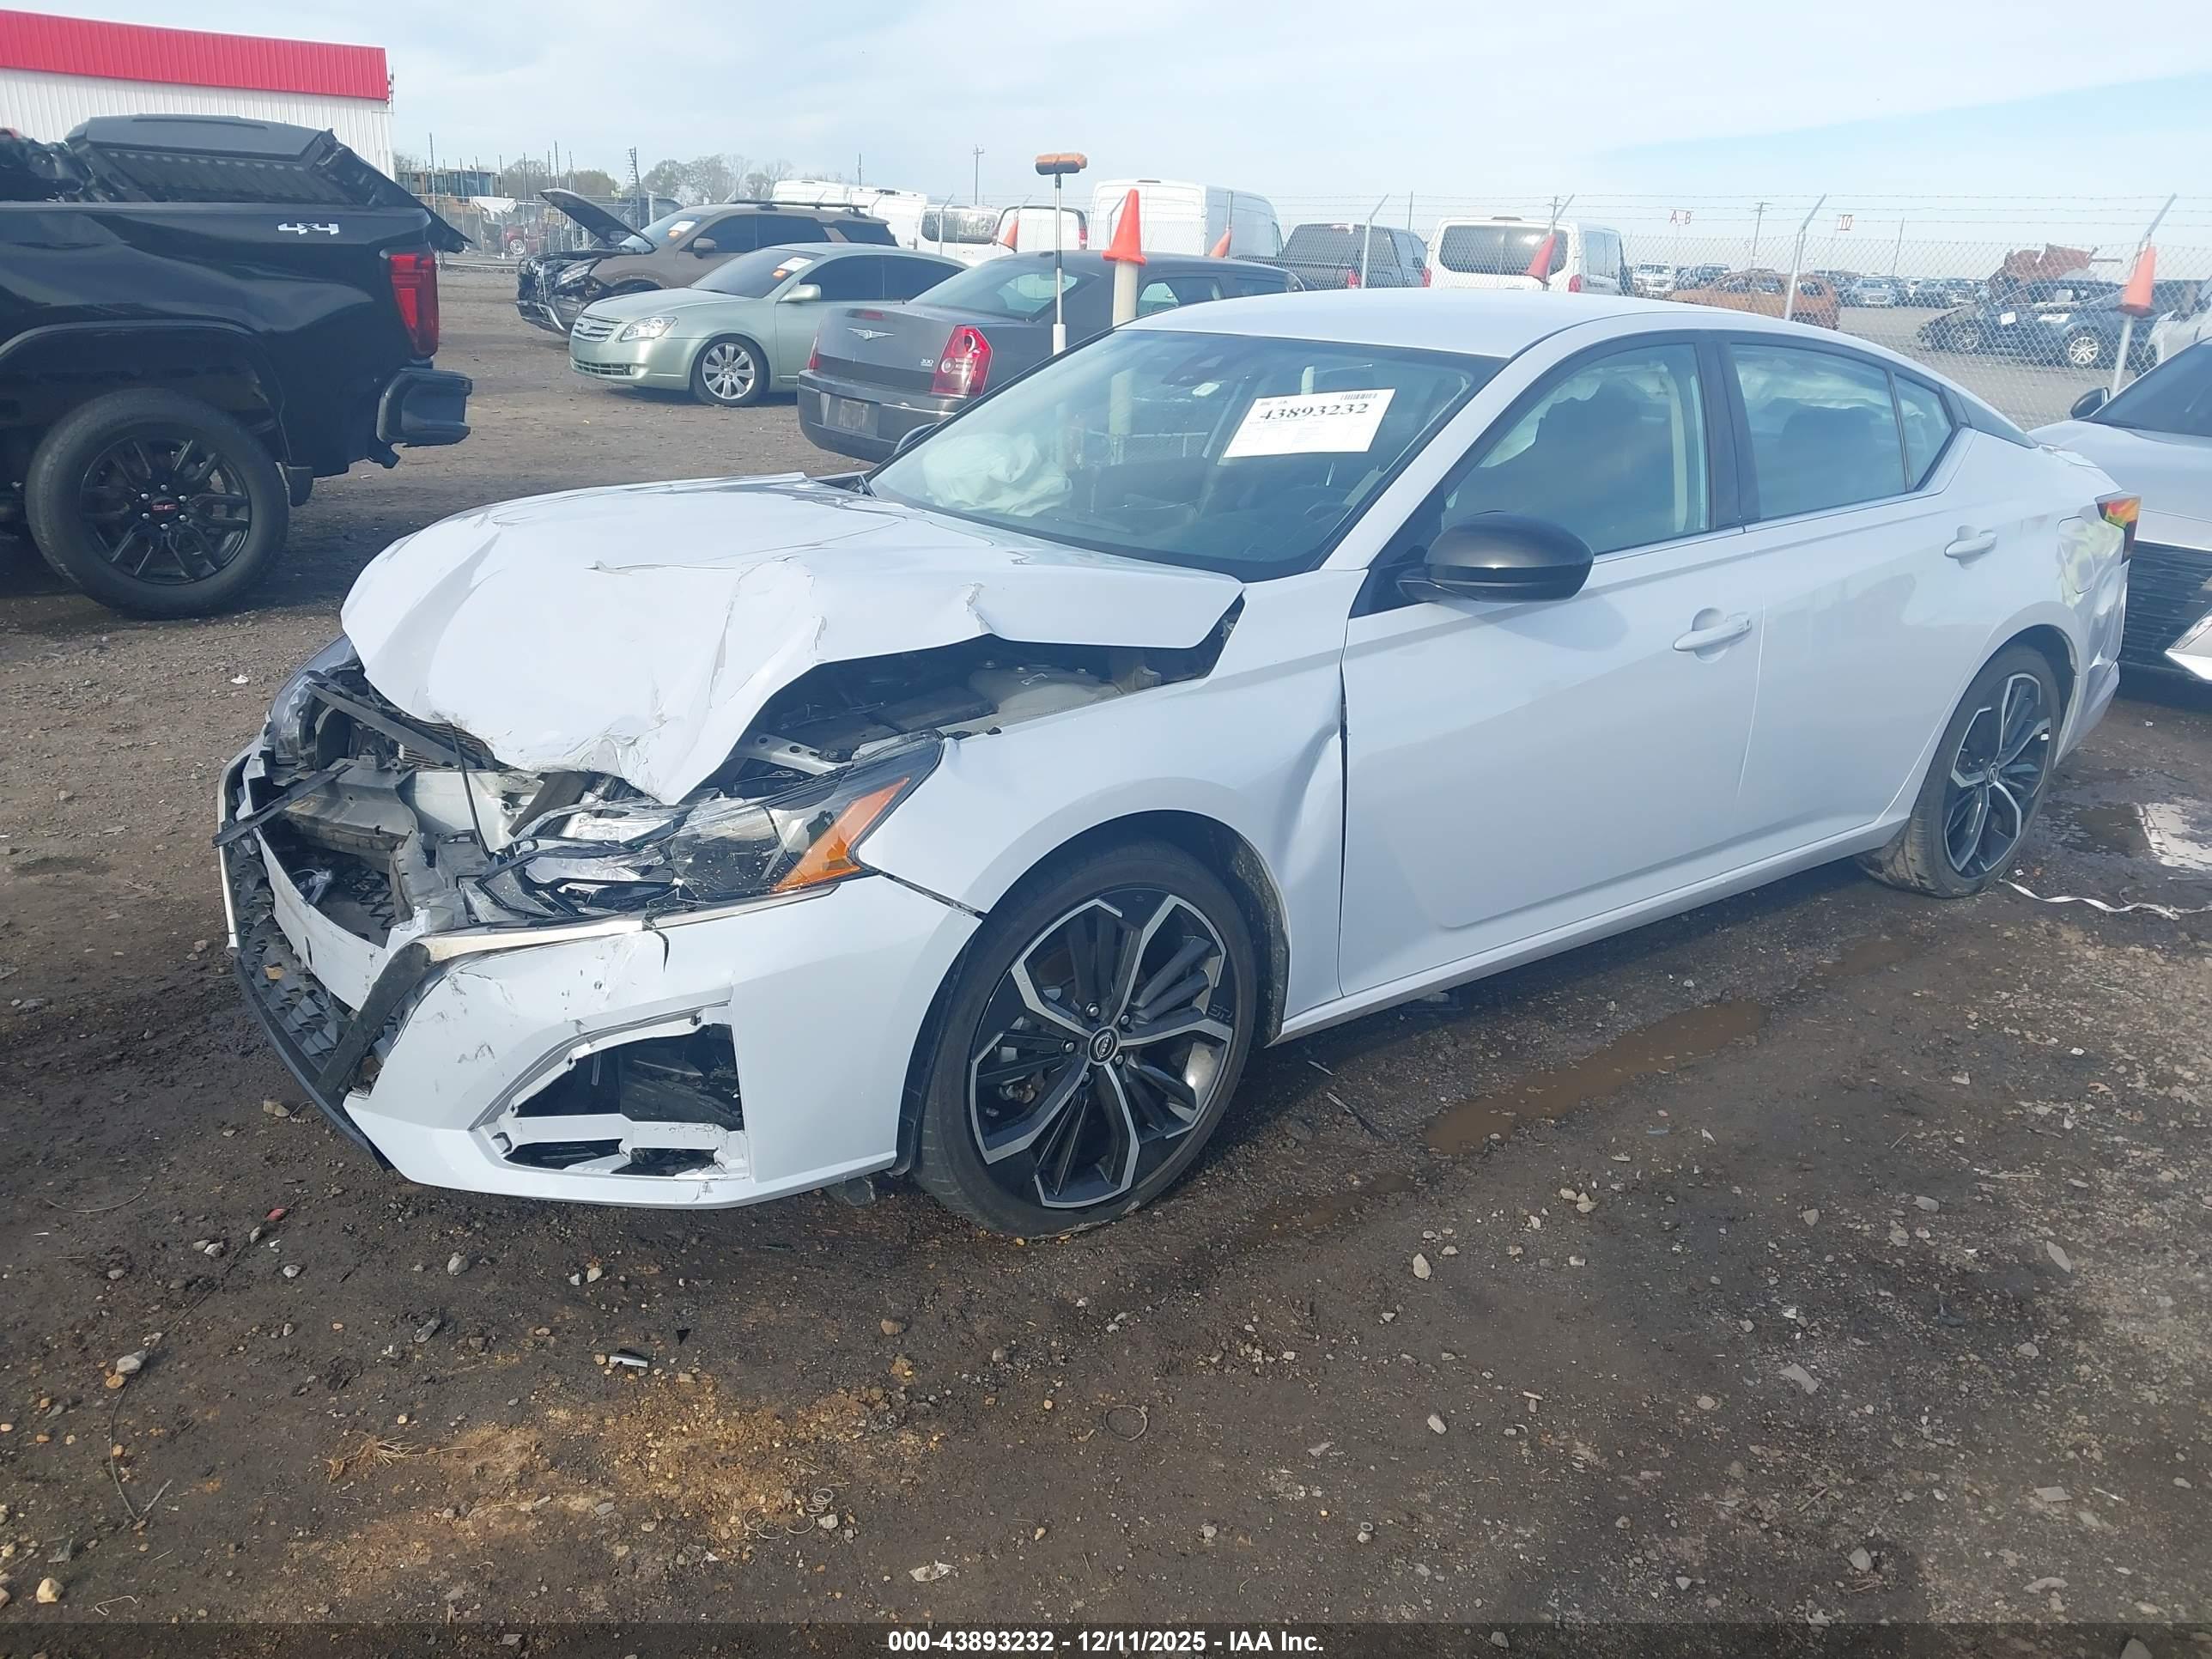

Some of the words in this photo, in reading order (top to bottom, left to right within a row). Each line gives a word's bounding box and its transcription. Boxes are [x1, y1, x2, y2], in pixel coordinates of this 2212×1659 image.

[1669, 210, 1678, 223] A
[1685, 211, 1692, 224] B
[1841, 215, 1853, 230] 10
[1260, 403, 1369, 420] 43893232
